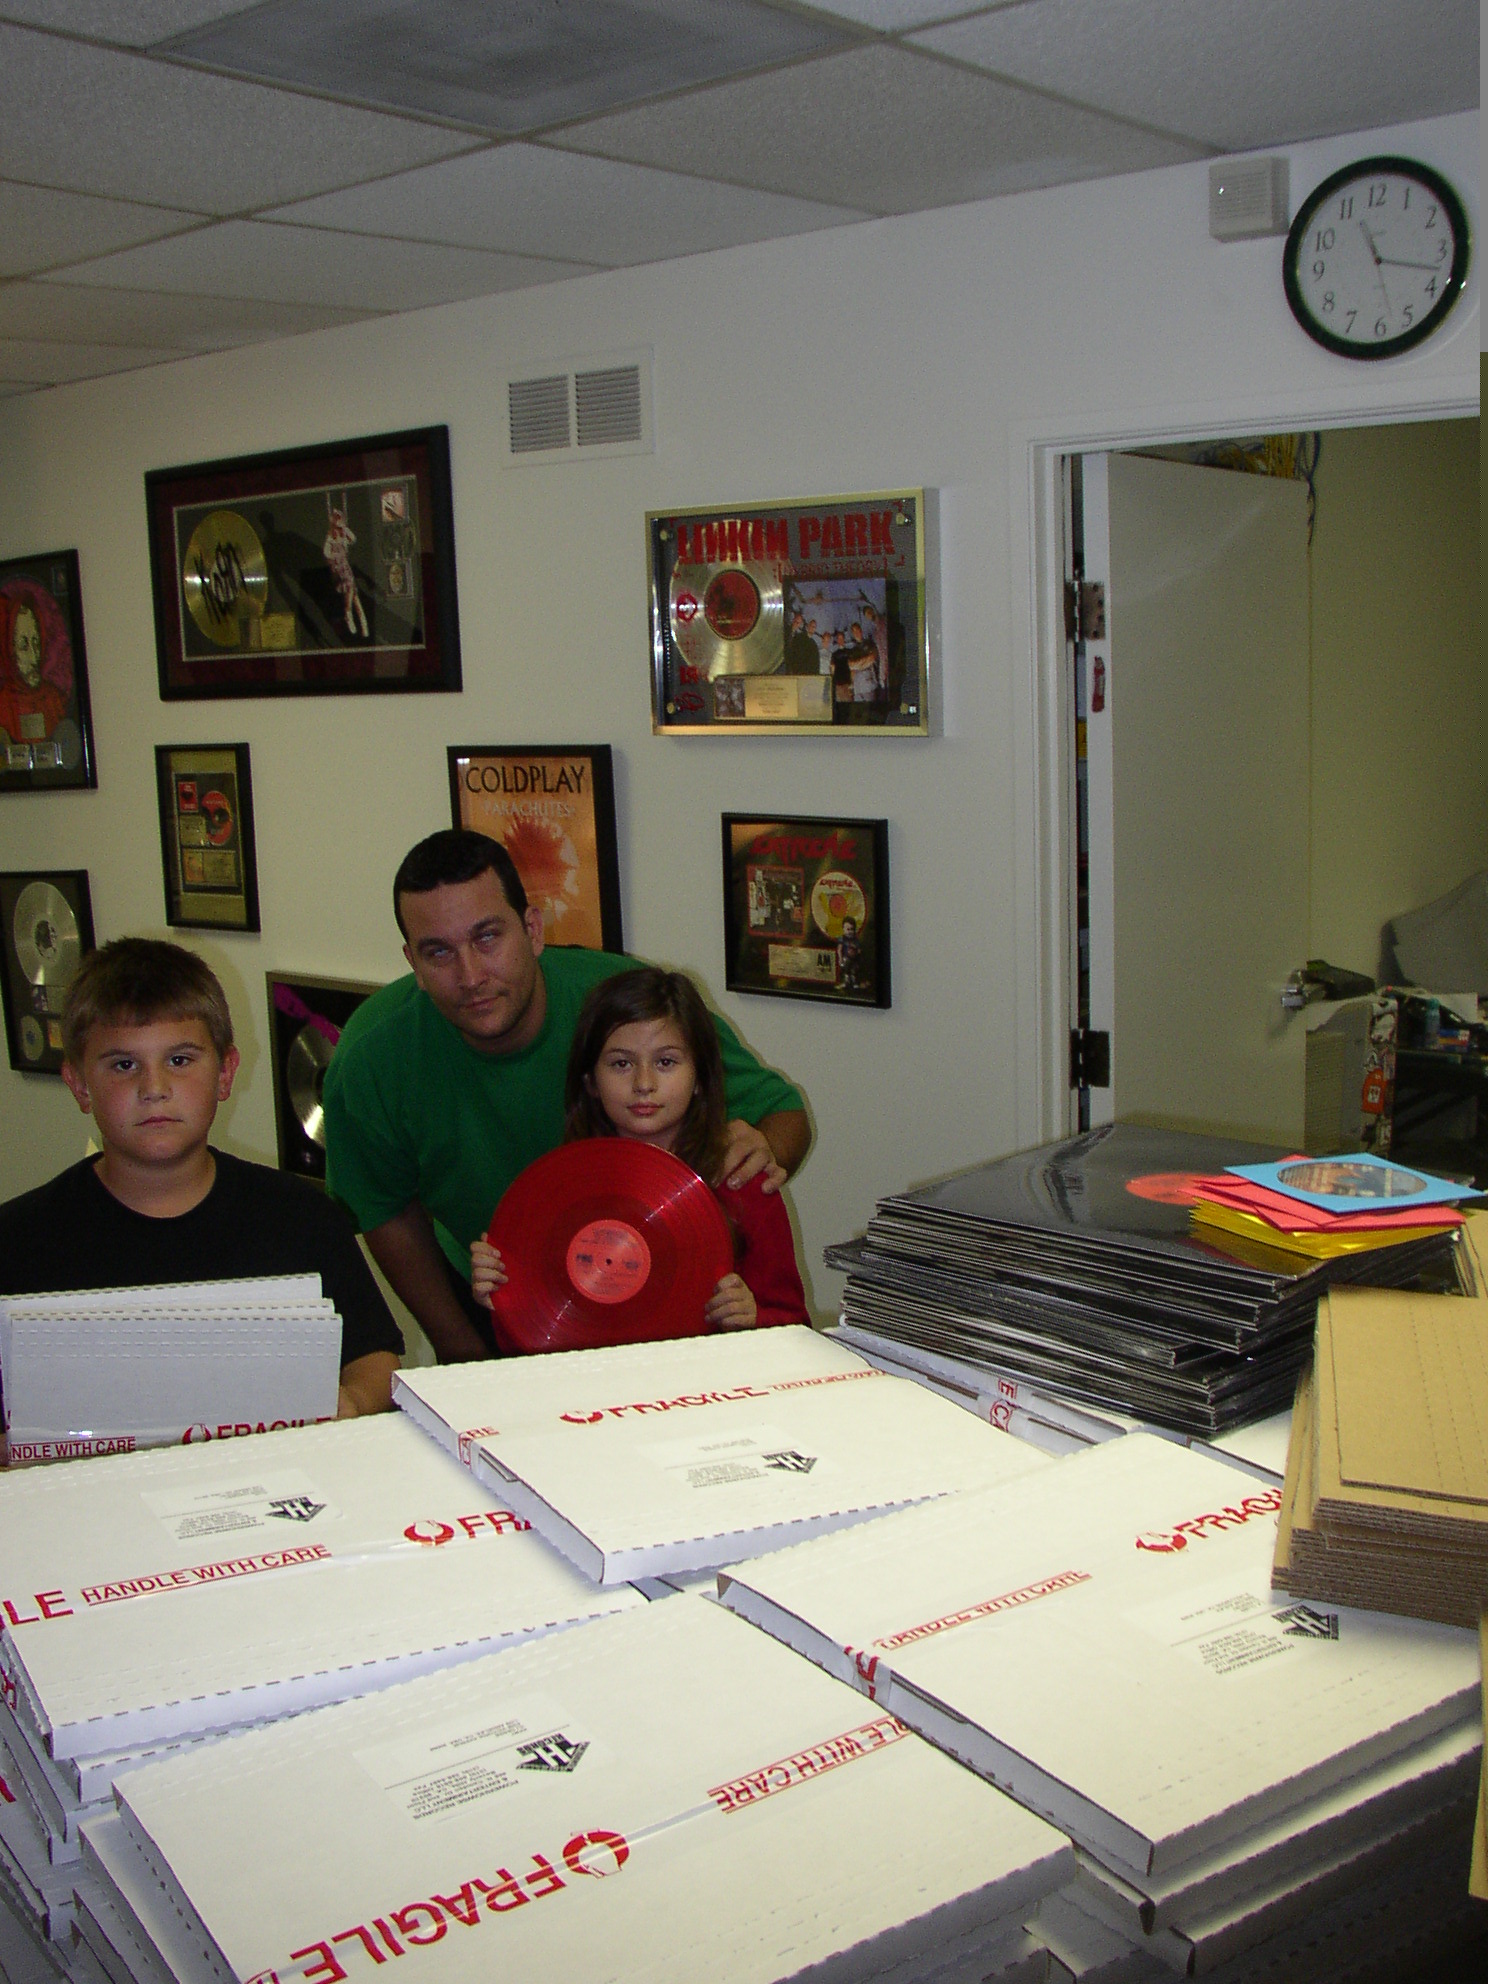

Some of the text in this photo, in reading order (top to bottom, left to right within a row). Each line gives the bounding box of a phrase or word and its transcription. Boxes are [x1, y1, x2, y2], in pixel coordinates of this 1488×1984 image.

[1368, 183, 1387, 208] 12
[1403, 186, 1411, 210] 1
[1339, 197, 1354, 220] 11
[1425, 205, 1437, 229] 2
[1315, 227, 1336, 252] 10
[1436, 238, 1448, 263] 3
[1312, 260, 1326, 282] 9
[1424, 275, 1438, 299] 4
[1321, 290, 1335, 314] 8
[1346, 309, 1358, 334] 7
[1373, 316, 1388, 337] 6
[1402, 303, 1414, 328] 5
[798, 511, 896, 560] PARK
[465, 765, 585, 794] COLDPLAY
[54, 1440, 93, 1458] WITH
[95, 1437, 136, 1454] CARE
[81, 1544, 332, 1605] HANDLE WITH CARE
[790, 1736, 866, 1778] WITH
[707, 1765, 793, 1813] CARE
[289, 1852, 569, 1984] FRAGILE
